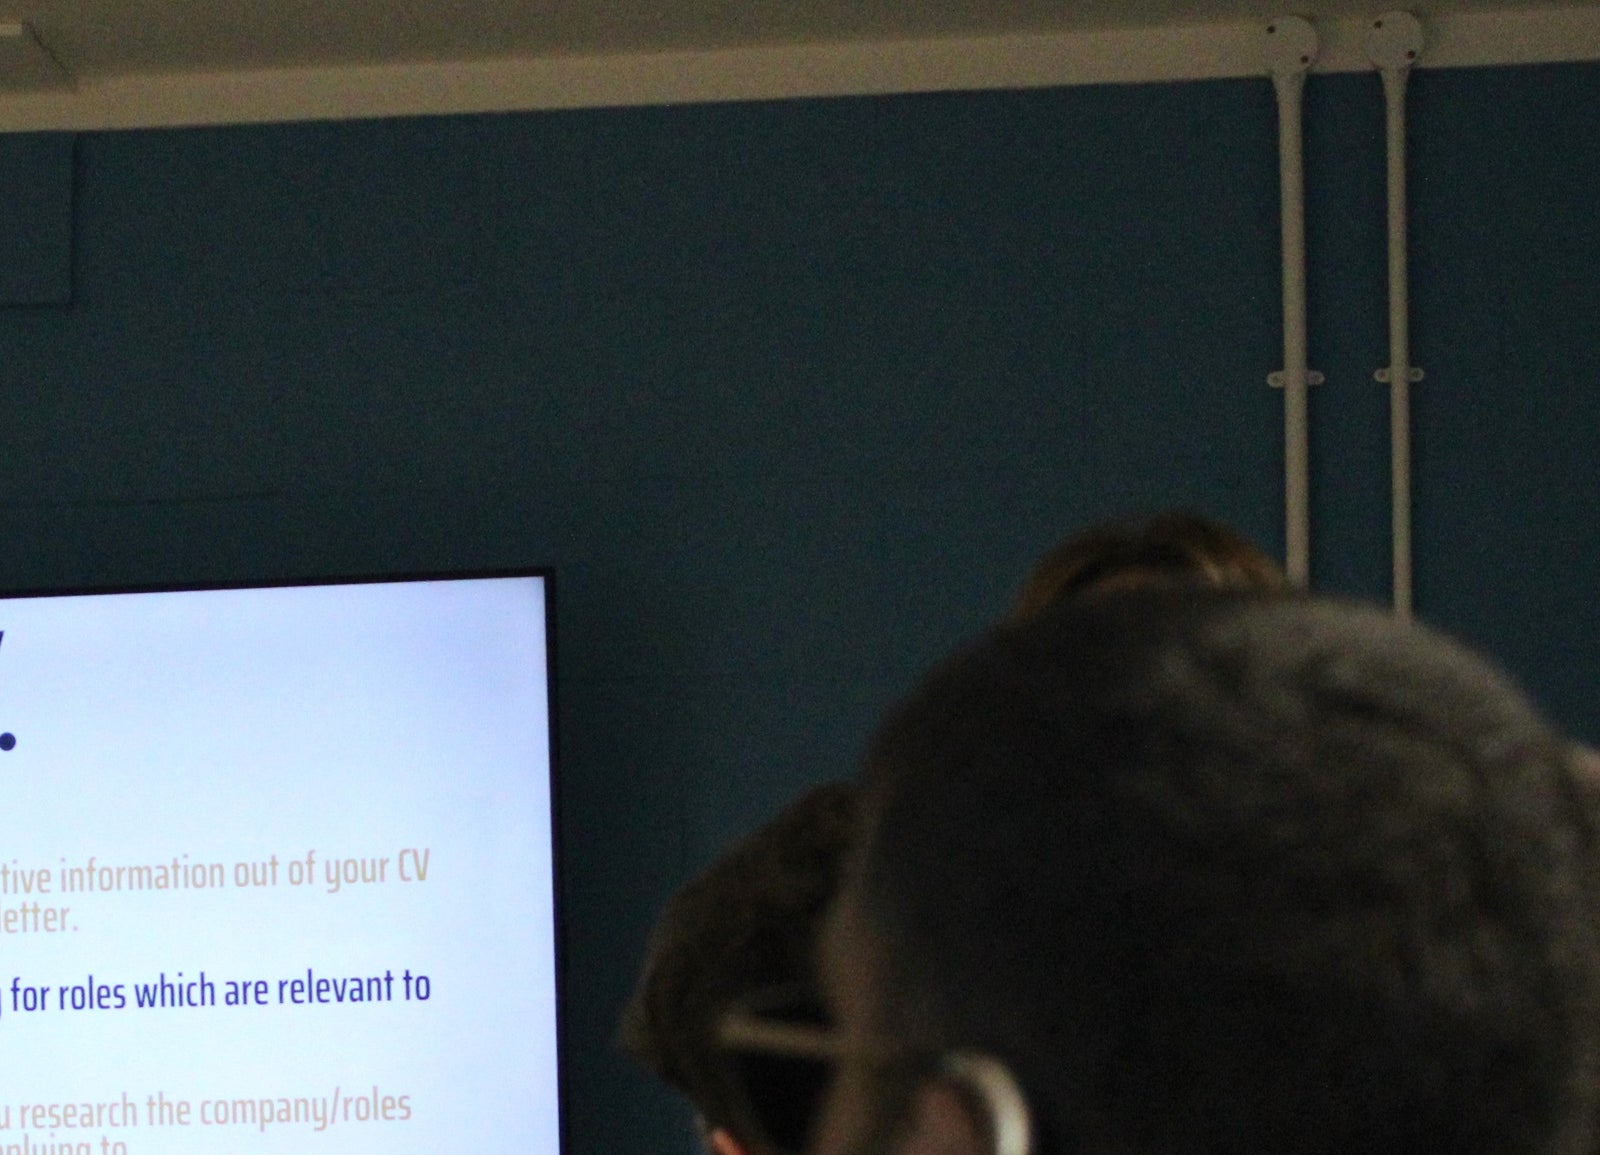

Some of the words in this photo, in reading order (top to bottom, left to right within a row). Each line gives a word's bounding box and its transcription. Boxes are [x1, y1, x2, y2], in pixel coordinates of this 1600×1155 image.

[61, 854, 224, 892] information
[234, 855, 279, 887] out
[288, 850, 315, 886] of
[325, 857, 389, 893] your
[398, 848, 430, 882] CV
[11, 977, 50, 1011] for
[59, 975, 126, 1010] roles
[135, 972, 215, 1008] which
[225, 980, 268, 1006] are
[279, 969, 394, 1004] relevant
[403, 970, 430, 1000] to
[20, 1092, 137, 1129] research
[146, 1091, 191, 1126] the
[201, 1086, 412, 1132] company/roles
